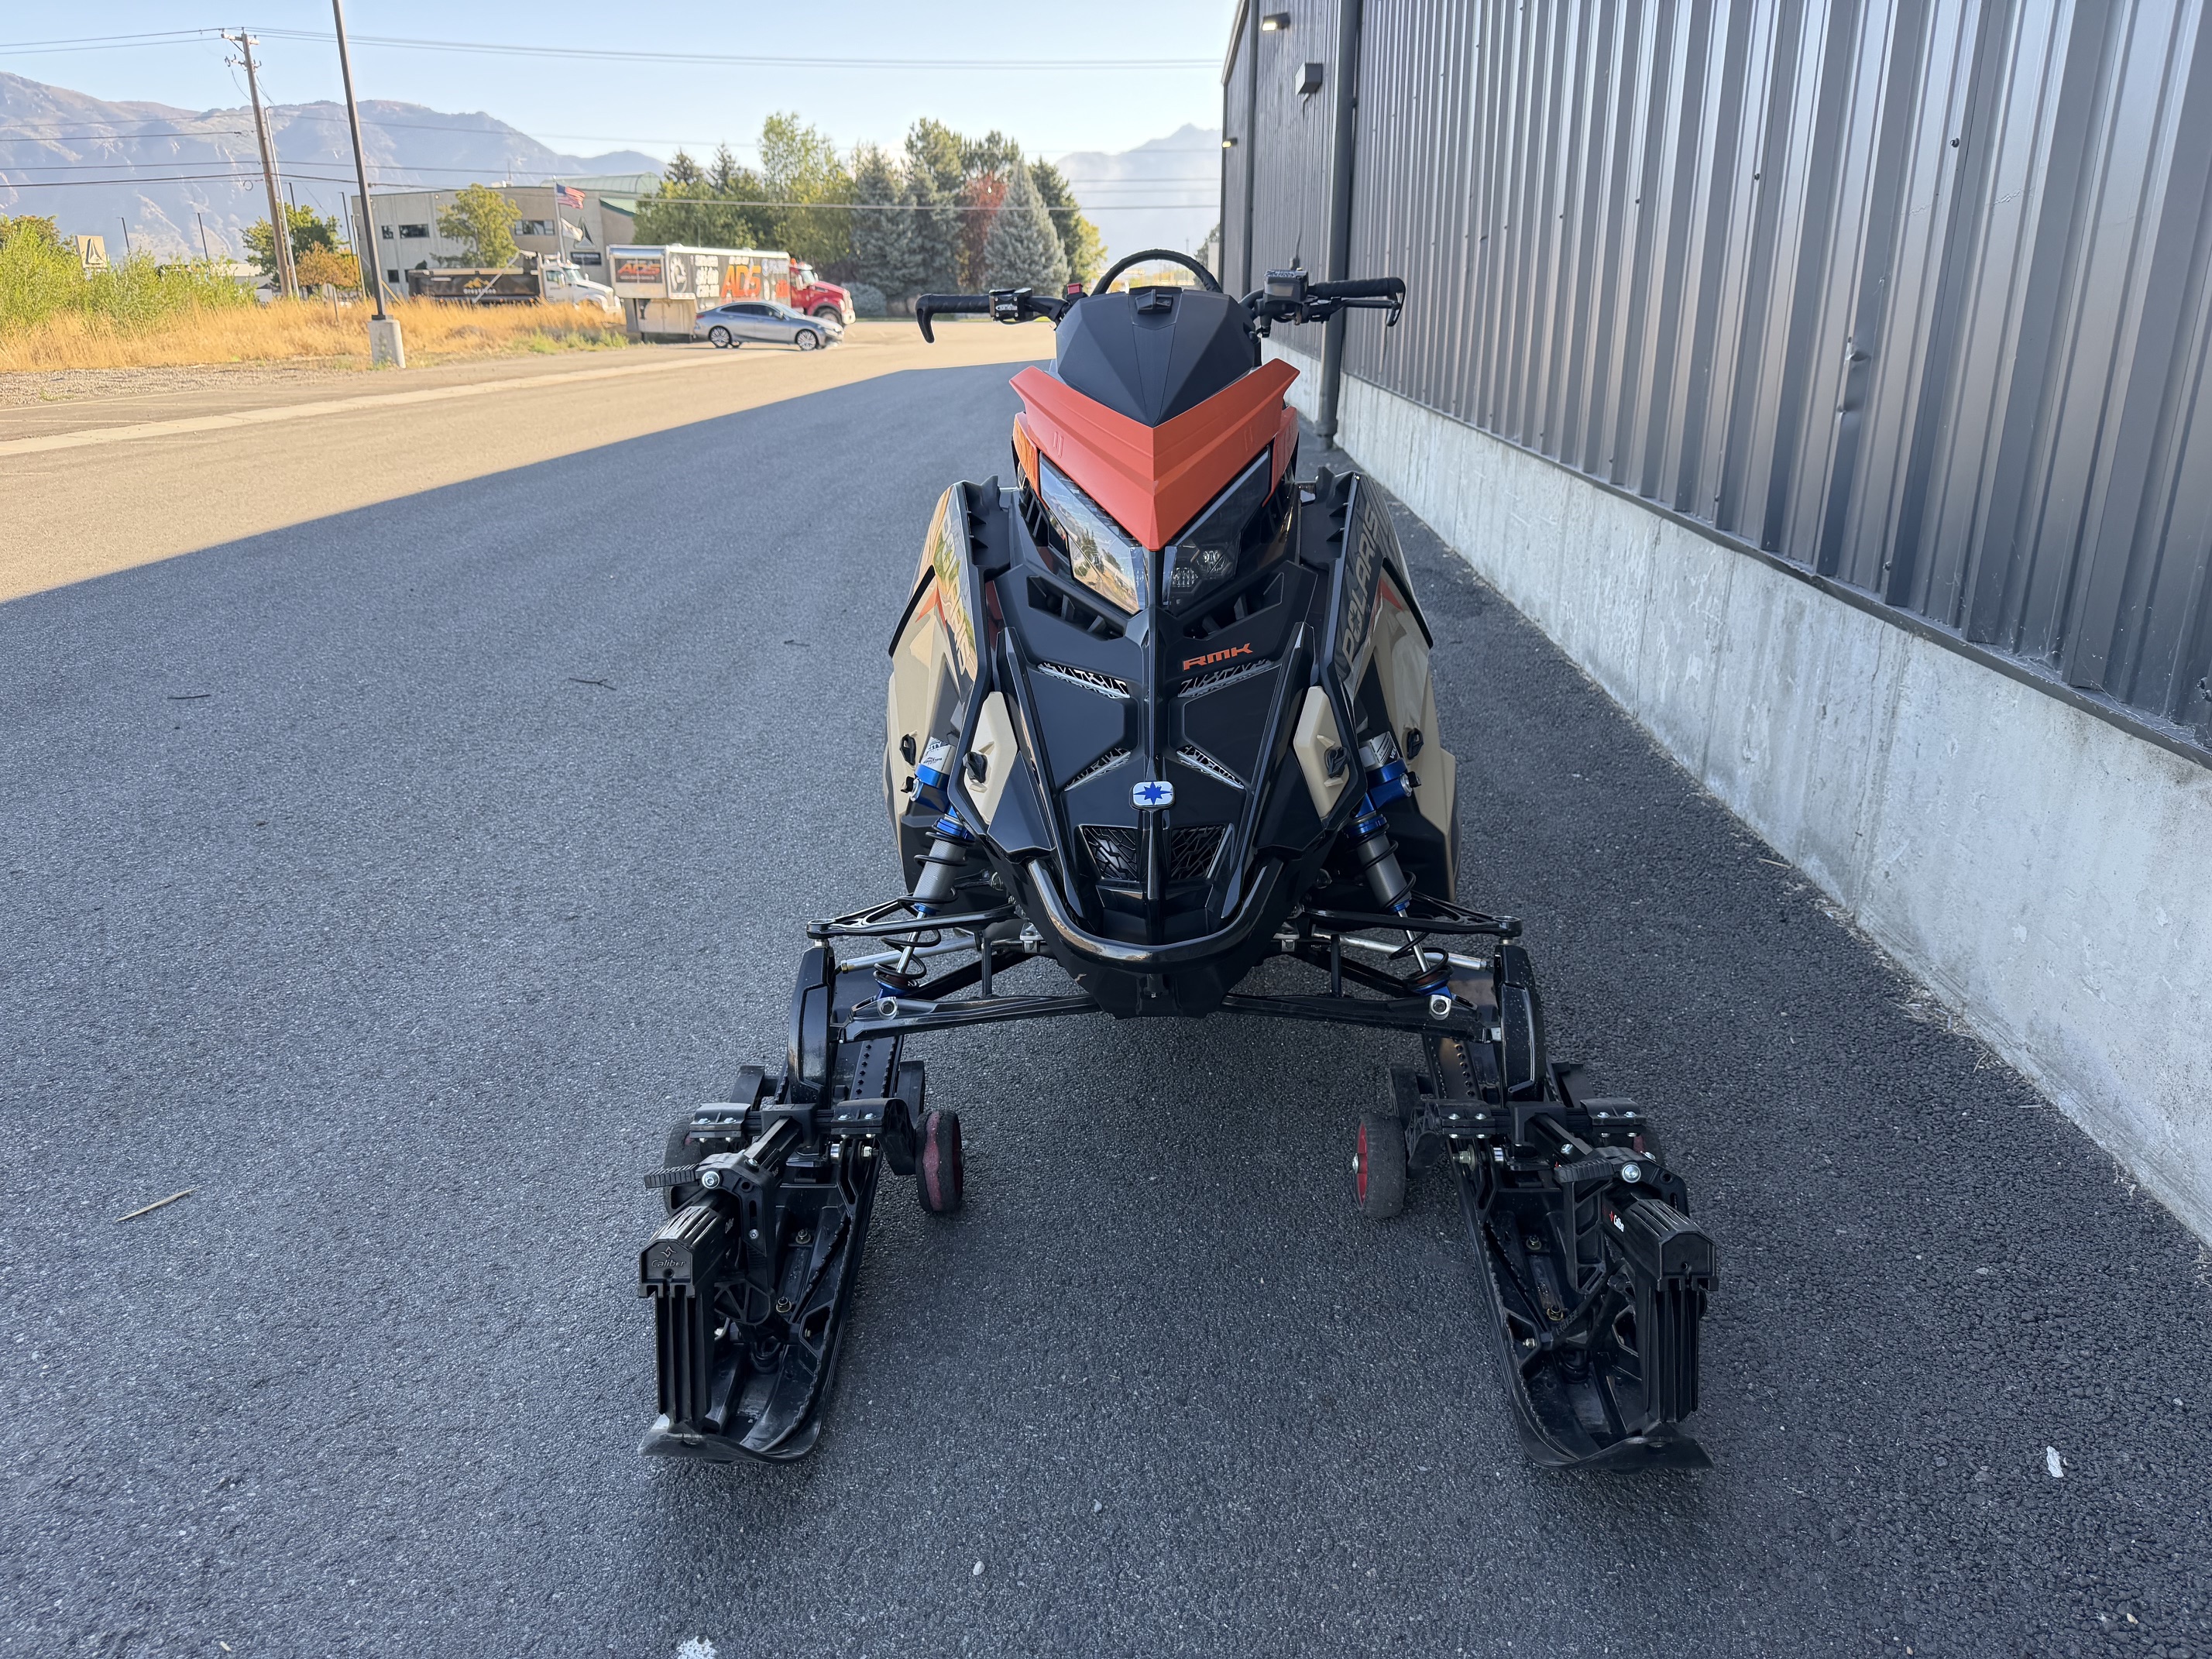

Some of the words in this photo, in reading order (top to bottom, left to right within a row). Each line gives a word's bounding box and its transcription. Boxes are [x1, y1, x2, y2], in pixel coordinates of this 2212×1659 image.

[617, 263, 661, 275] ADS
[720, 265, 761, 298] ADS
[1342, 501, 1379, 671] POLARIS
[1183, 643, 1253, 671] RMK
[651, 1259, 686, 1268] Caliber
